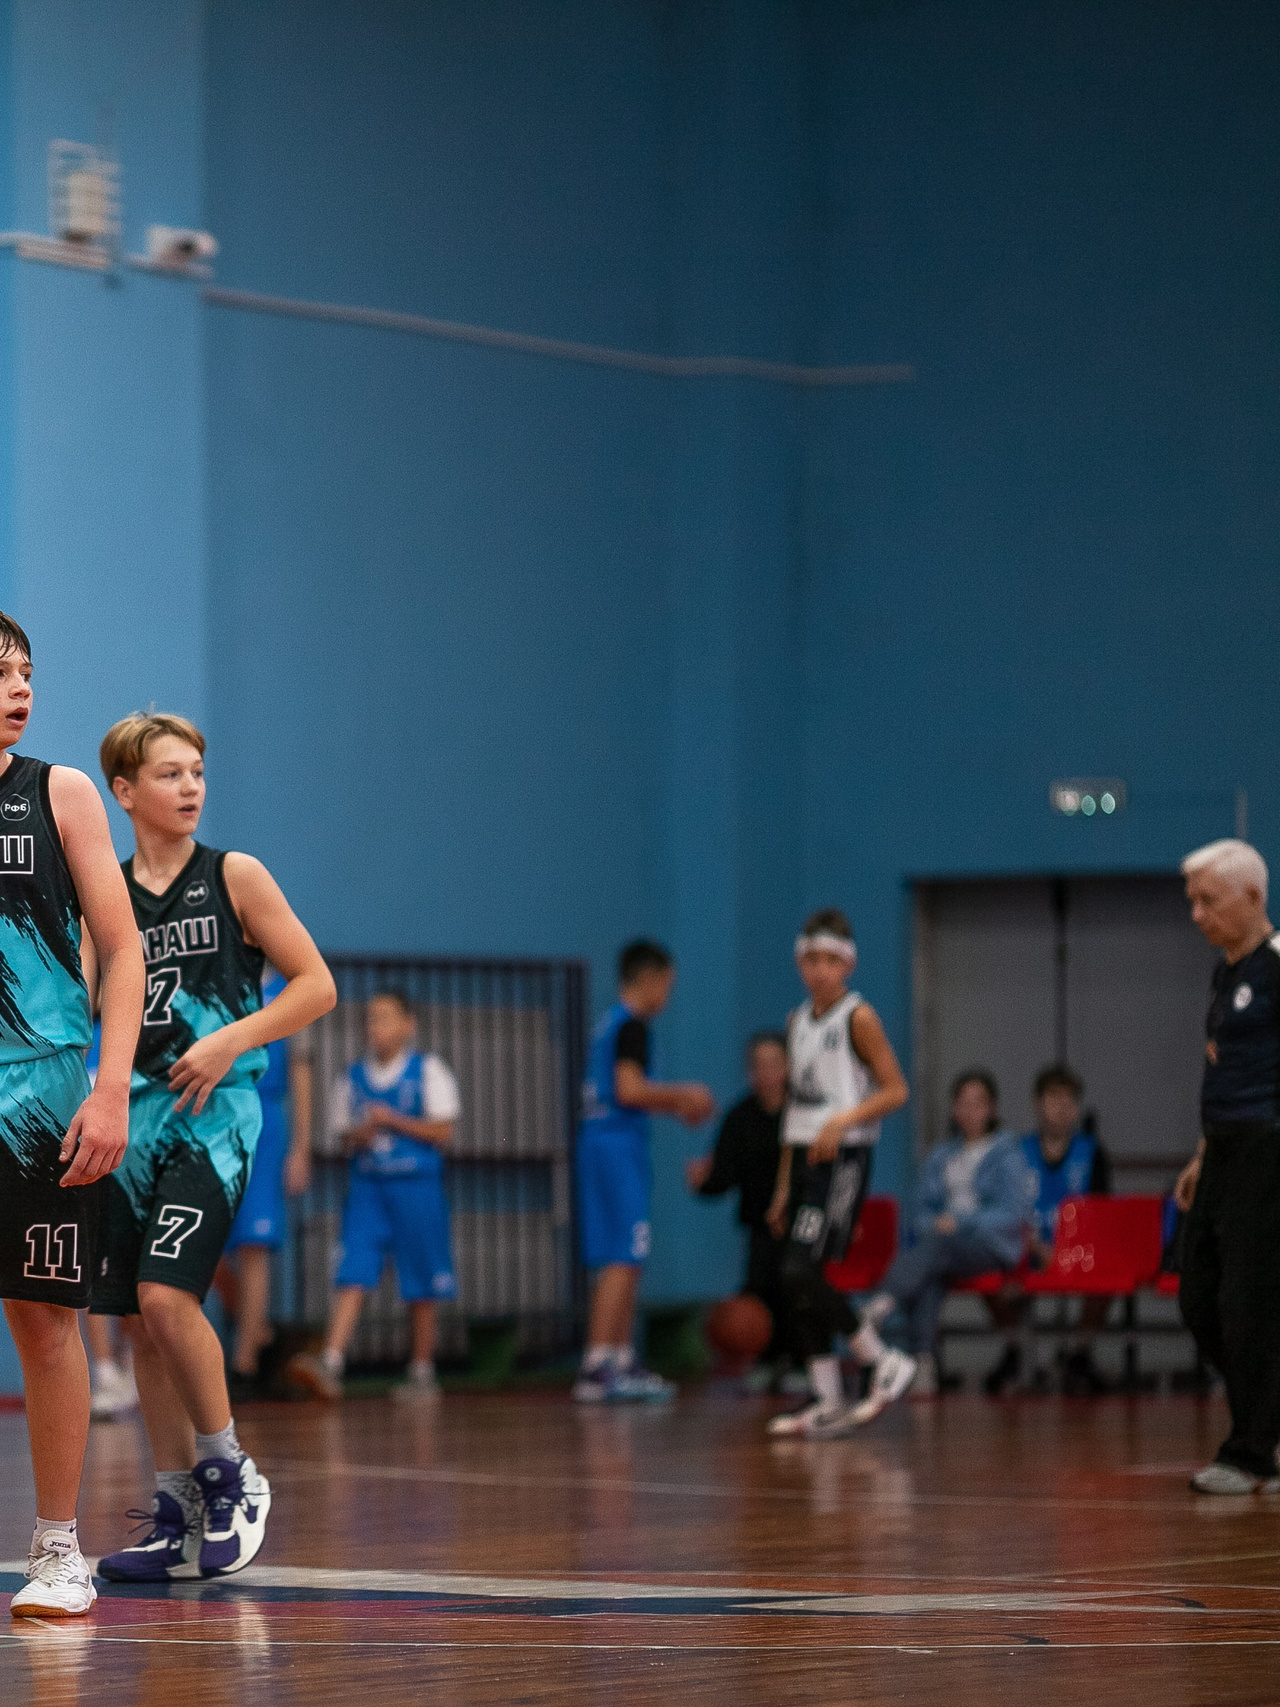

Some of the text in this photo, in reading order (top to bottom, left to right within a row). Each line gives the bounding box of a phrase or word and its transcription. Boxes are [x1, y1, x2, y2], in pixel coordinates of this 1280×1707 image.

[139, 916, 218, 965] НАШ
[143, 967, 181, 1026] 7
[23, 1223, 82, 1283] 11
[150, 1205, 204, 1259] 7
